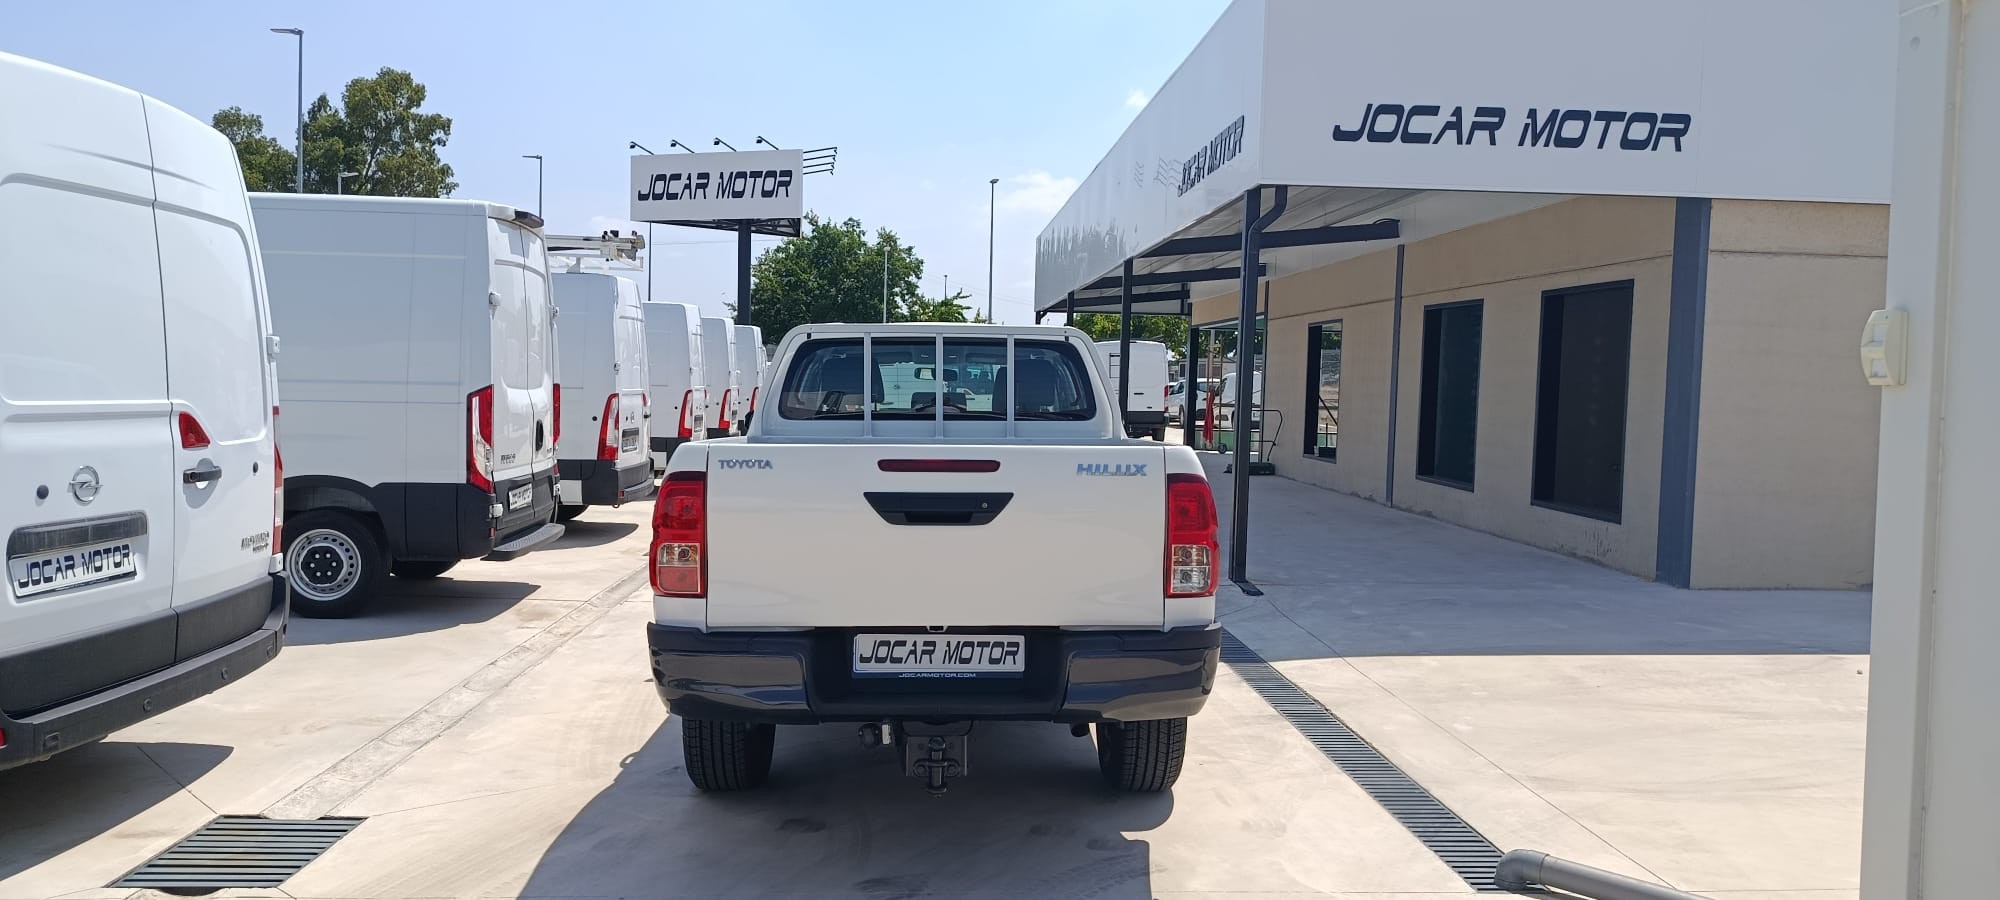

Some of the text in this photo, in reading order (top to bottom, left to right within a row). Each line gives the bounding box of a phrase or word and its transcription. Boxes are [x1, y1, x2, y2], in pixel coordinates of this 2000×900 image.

[1332, 103, 1692, 152] JOCAR MOTOR
[1177, 114, 1245, 198] JOCAR MOTOR
[637, 169, 793, 201] JOCAR MOTOR
[718, 459, 773, 469] TOYOTA
[1076, 463, 1148, 475] HILUX
[17, 554, 77, 588] JOCAR
[81, 543, 131, 576] MOTOR
[859, 640, 1020, 665] JOCAR MOTOR
